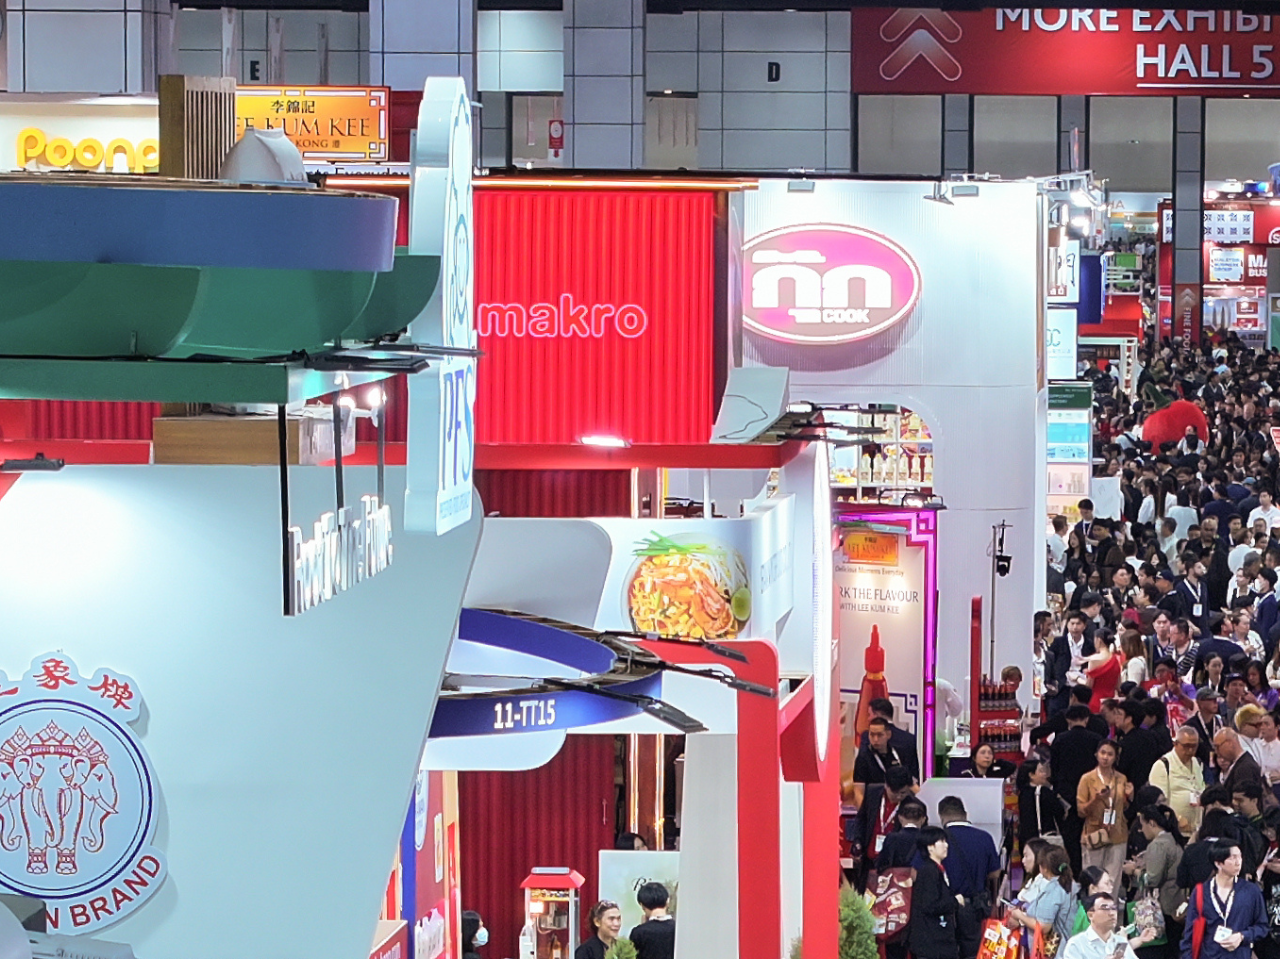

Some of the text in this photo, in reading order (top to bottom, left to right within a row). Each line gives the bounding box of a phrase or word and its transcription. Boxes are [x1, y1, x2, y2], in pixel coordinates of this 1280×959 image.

[250, 60, 260, 81] E
[767, 61, 781, 83] D
[1136, 44, 1241, 78] HALL
[1250, 44, 1274, 79] 5
[330, 117, 370, 137] KEE
[477, 293, 647, 338] makro
[822, 308, 870, 324] COOK
[852, 587, 872, 600] THE
[874, 588, 919, 603] FLAVOUR
[840, 602, 900, 615] WITH LEE KUM KEE
[493, 699, 556, 728] 11-TT15
[69, 854, 161, 928] BRAND
